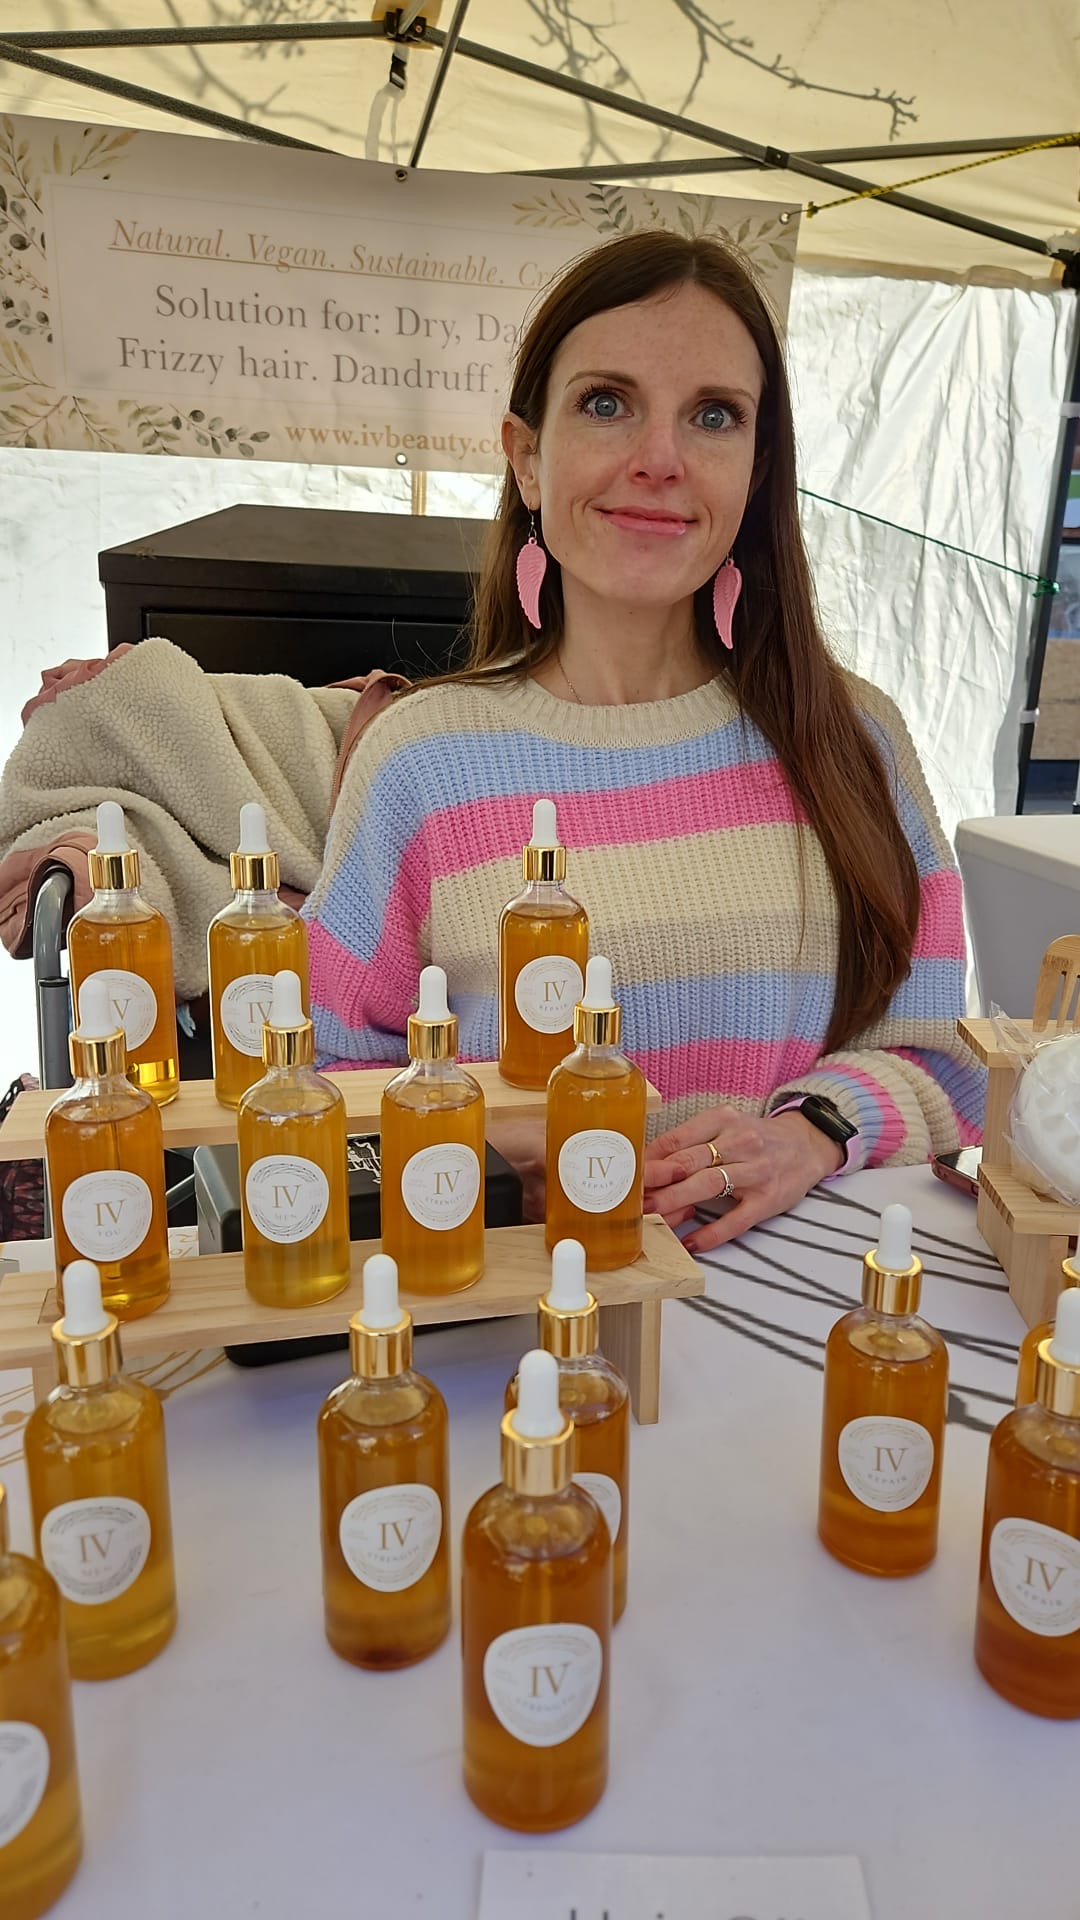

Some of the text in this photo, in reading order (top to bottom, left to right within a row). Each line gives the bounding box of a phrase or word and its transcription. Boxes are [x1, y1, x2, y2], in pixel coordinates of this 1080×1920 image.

[111, 219, 231, 258] Natural.
[247, 233, 335, 273] Vegan.
[350, 245, 505, 284] Sustainable.
[156, 284, 528, 350] Solution for: Dry, Da
[117, 336, 500, 394] Frizzy hair. Dandruff.
[543, 980, 568, 1002] IV
[248, 1001, 273, 1024] IV
[433, 1169, 463, 1195] IV
[584, 1155, 616, 1179] IV
[272, 1184, 302, 1209] IV
[93, 1199, 126, 1227] IV
[872, 1445, 909, 1472] IV
[77, 1528, 115, 1564] IV
[378, 1516, 416, 1551] IV
[1024, 1553, 1067, 1593] IV
[527, 1661, 574, 1698] IV
